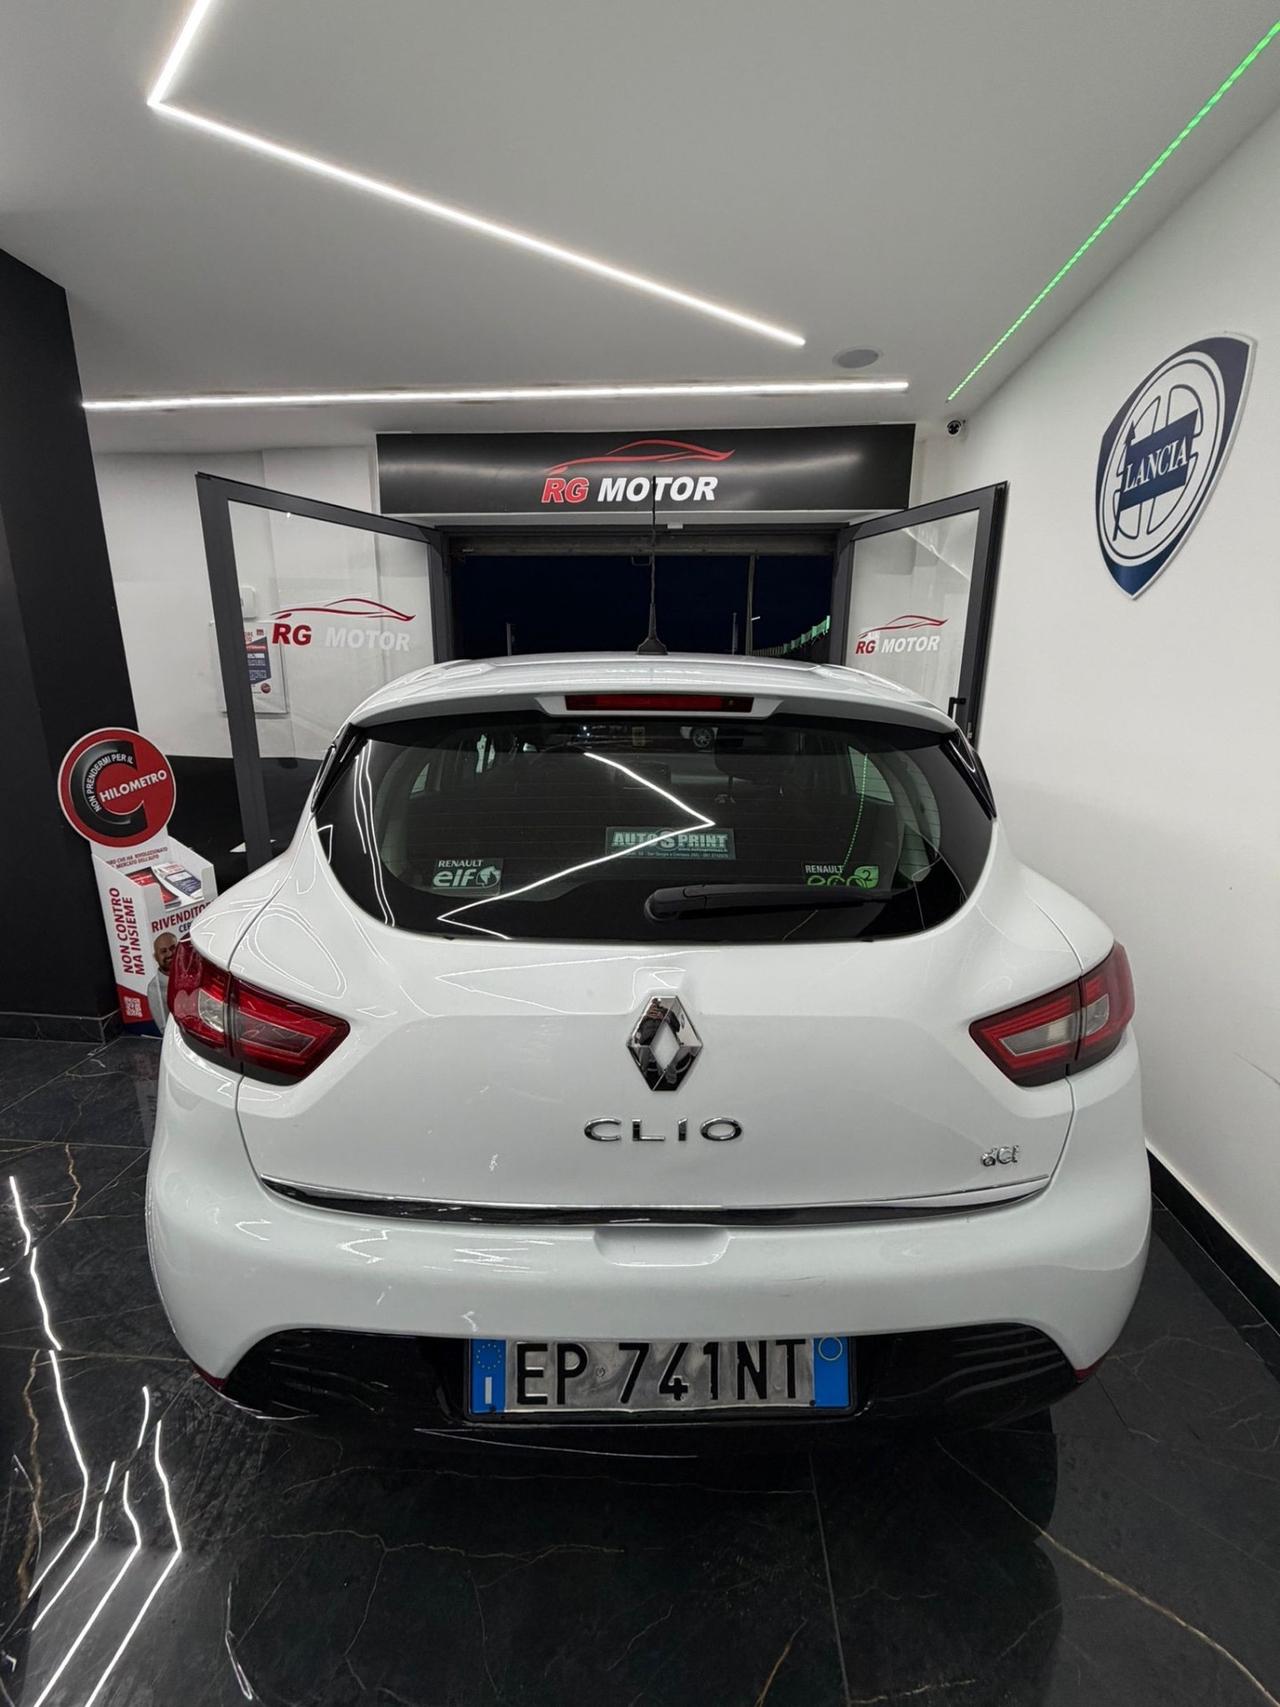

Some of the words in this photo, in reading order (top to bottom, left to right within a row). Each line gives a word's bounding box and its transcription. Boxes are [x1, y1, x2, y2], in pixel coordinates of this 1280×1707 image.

[1123, 437, 1188, 492] LANCIA
[541, 477, 590, 503] RG
[597, 477, 718, 502] MOTOR
[272, 622, 312, 645] RG
[325, 627, 410, 651] MOTOR
[855, 639, 876, 655] RG
[881, 635, 940, 654] MOTOR
[111, 754, 127, 762] PER
[86, 756, 111, 794] PRENDERMI
[88, 795, 102, 812] NON
[438, 859, 484, 868] RENAULT
[804, 865, 846, 874] RENAULT
[432, 868, 477, 887] elf
[108, 887, 129, 942] CONTRO
[121, 896, 142, 952] INSIEME
[121, 945, 135, 975] NON
[132, 955, 146, 976] MA
[584, 1117, 743, 1142] CLIO
[516, 1342, 589, 1405] EP
[618, 1339, 807, 1405] 741NT
